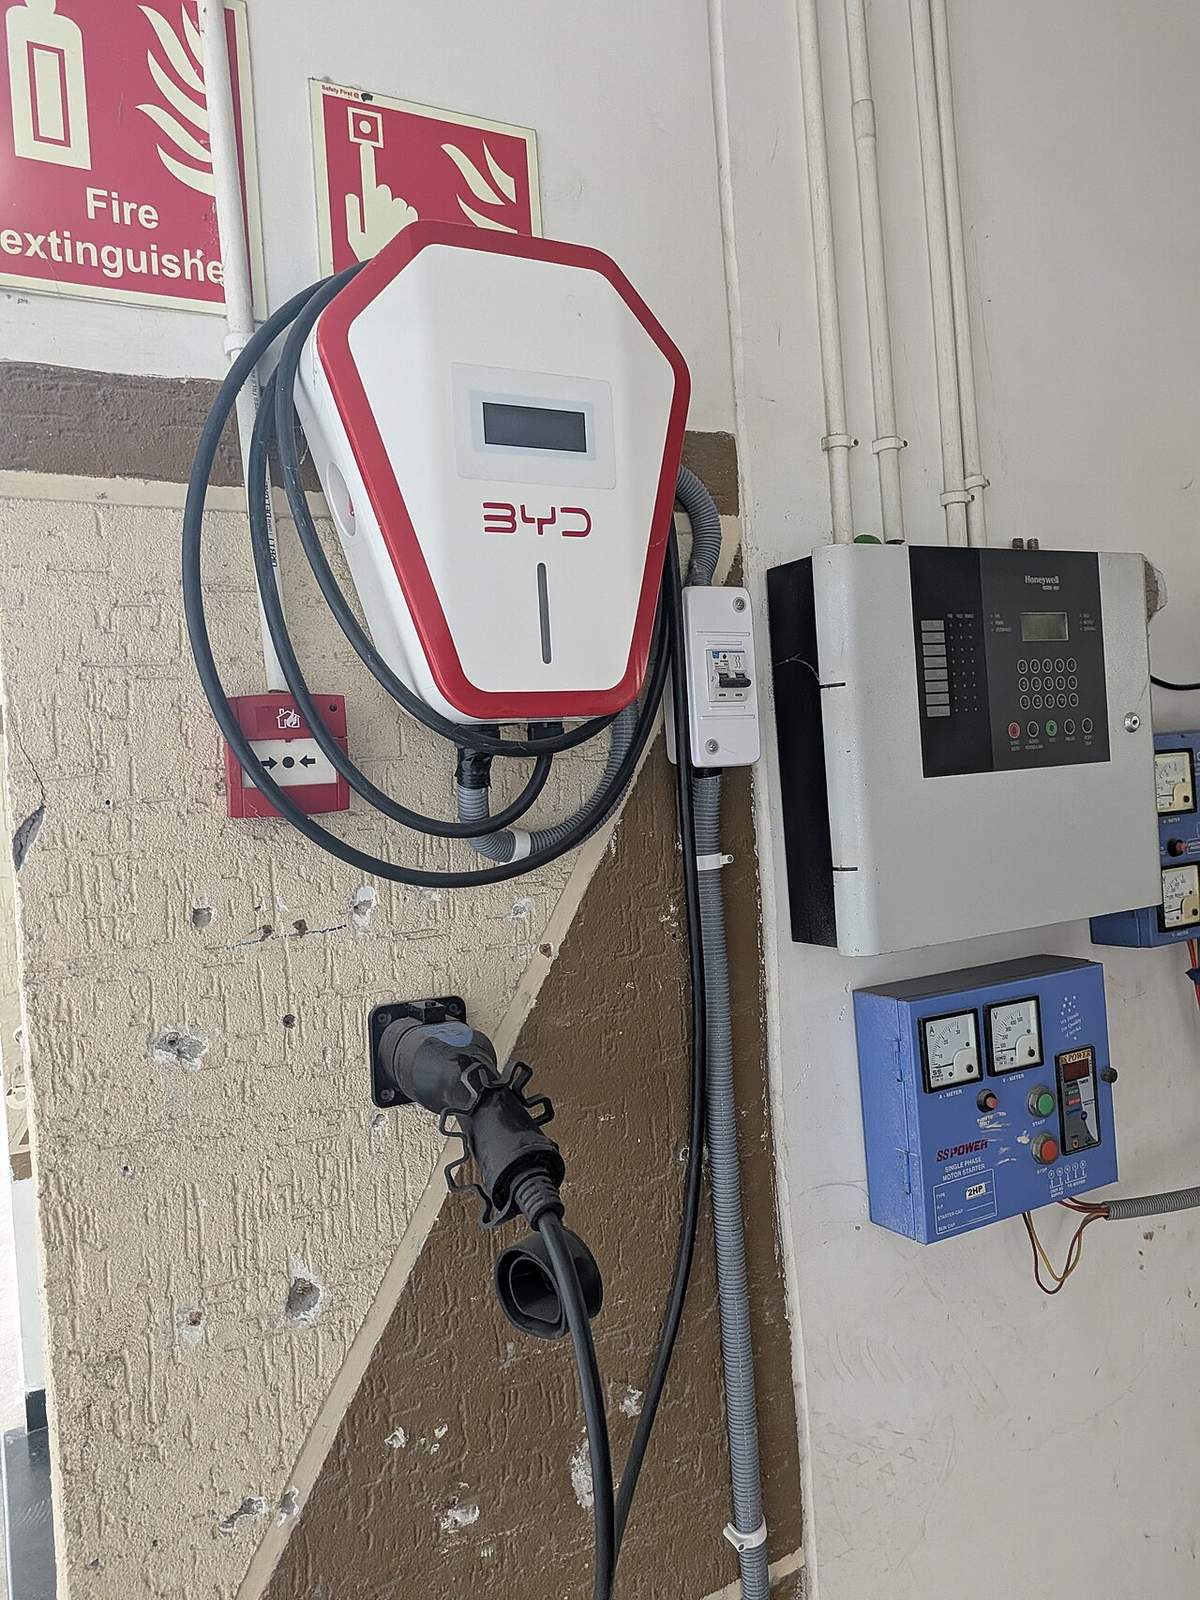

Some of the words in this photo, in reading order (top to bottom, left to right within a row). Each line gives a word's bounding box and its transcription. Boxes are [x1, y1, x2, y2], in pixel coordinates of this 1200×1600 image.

[85, 187, 159, 229] Fire
[0, 228, 225, 288] extinguishe
[482, 502, 593, 538] BYD
[1024, 575, 1060, 586] Honeywell
[929, 1026, 935, 1034] A
[942, 1169, 961, 1181] MOTOR
[962, 1163, 985, 1176] STARTER
[944, 1162, 964, 1173] SINGLE
[964, 1156, 982, 1167] PHASE
[968, 1185, 983, 1196] 2HP
